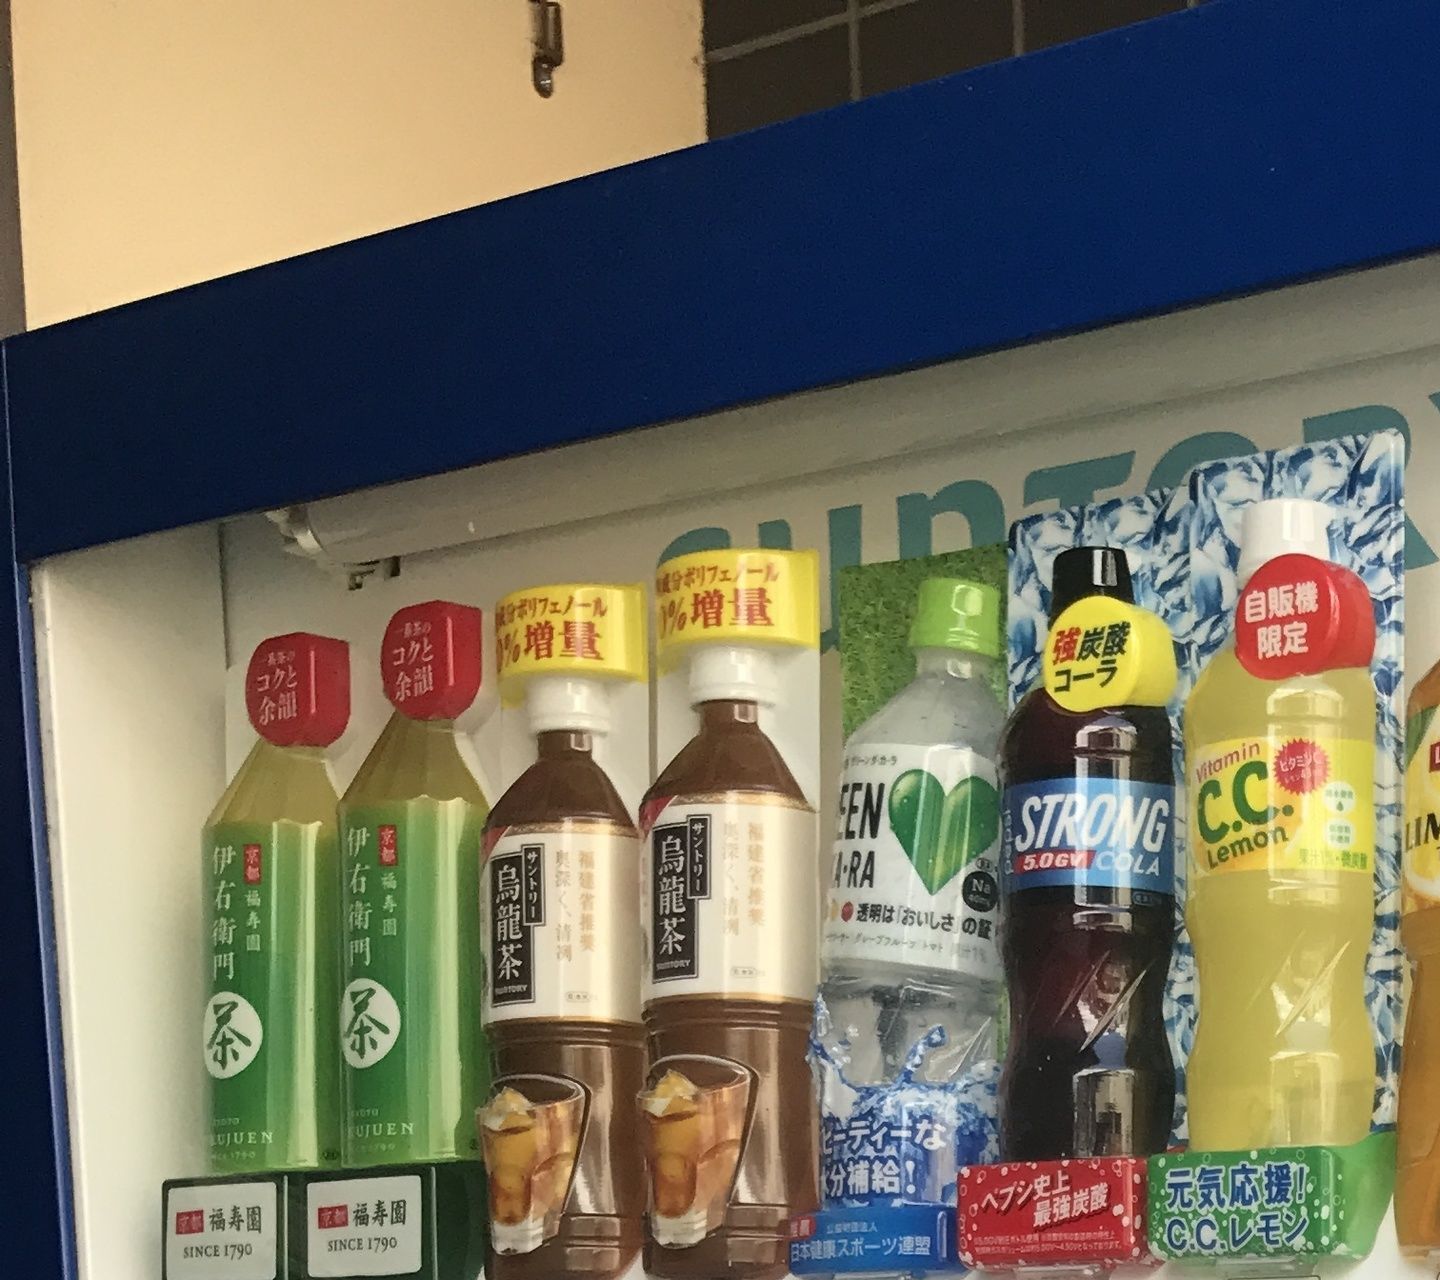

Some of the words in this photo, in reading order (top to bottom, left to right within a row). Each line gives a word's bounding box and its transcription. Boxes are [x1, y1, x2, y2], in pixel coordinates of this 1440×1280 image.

[1245, 581, 1318, 622] 自販機
[1053, 622, 1130, 665] 強炭酸
[1258, 622, 1309, 660] 限定
[1054, 659, 1117, 693] コーラ
[1197, 742, 1260, 782] Vitamin
[1016, 794, 1170, 852] STRONG
[1198, 760, 1294, 844] C.C.
[692, 823, 704, 892] サントリー
[1095, 853, 1159, 876] COLA
[1208, 825, 1288, 870] Lemon
[656, 836, 686, 955] 烏龍茶
[1033, 1183, 1107, 1227] 最強炭酸
[1166, 1164, 1306, 1209] 元気応援!
[353, 1200, 406, 1226] 福寿園
[1169, 1211, 1308, 1251] C.C.レモン
[328, 1238, 363, 1252] SINCE
[367, 1236, 397, 1252] 1790
